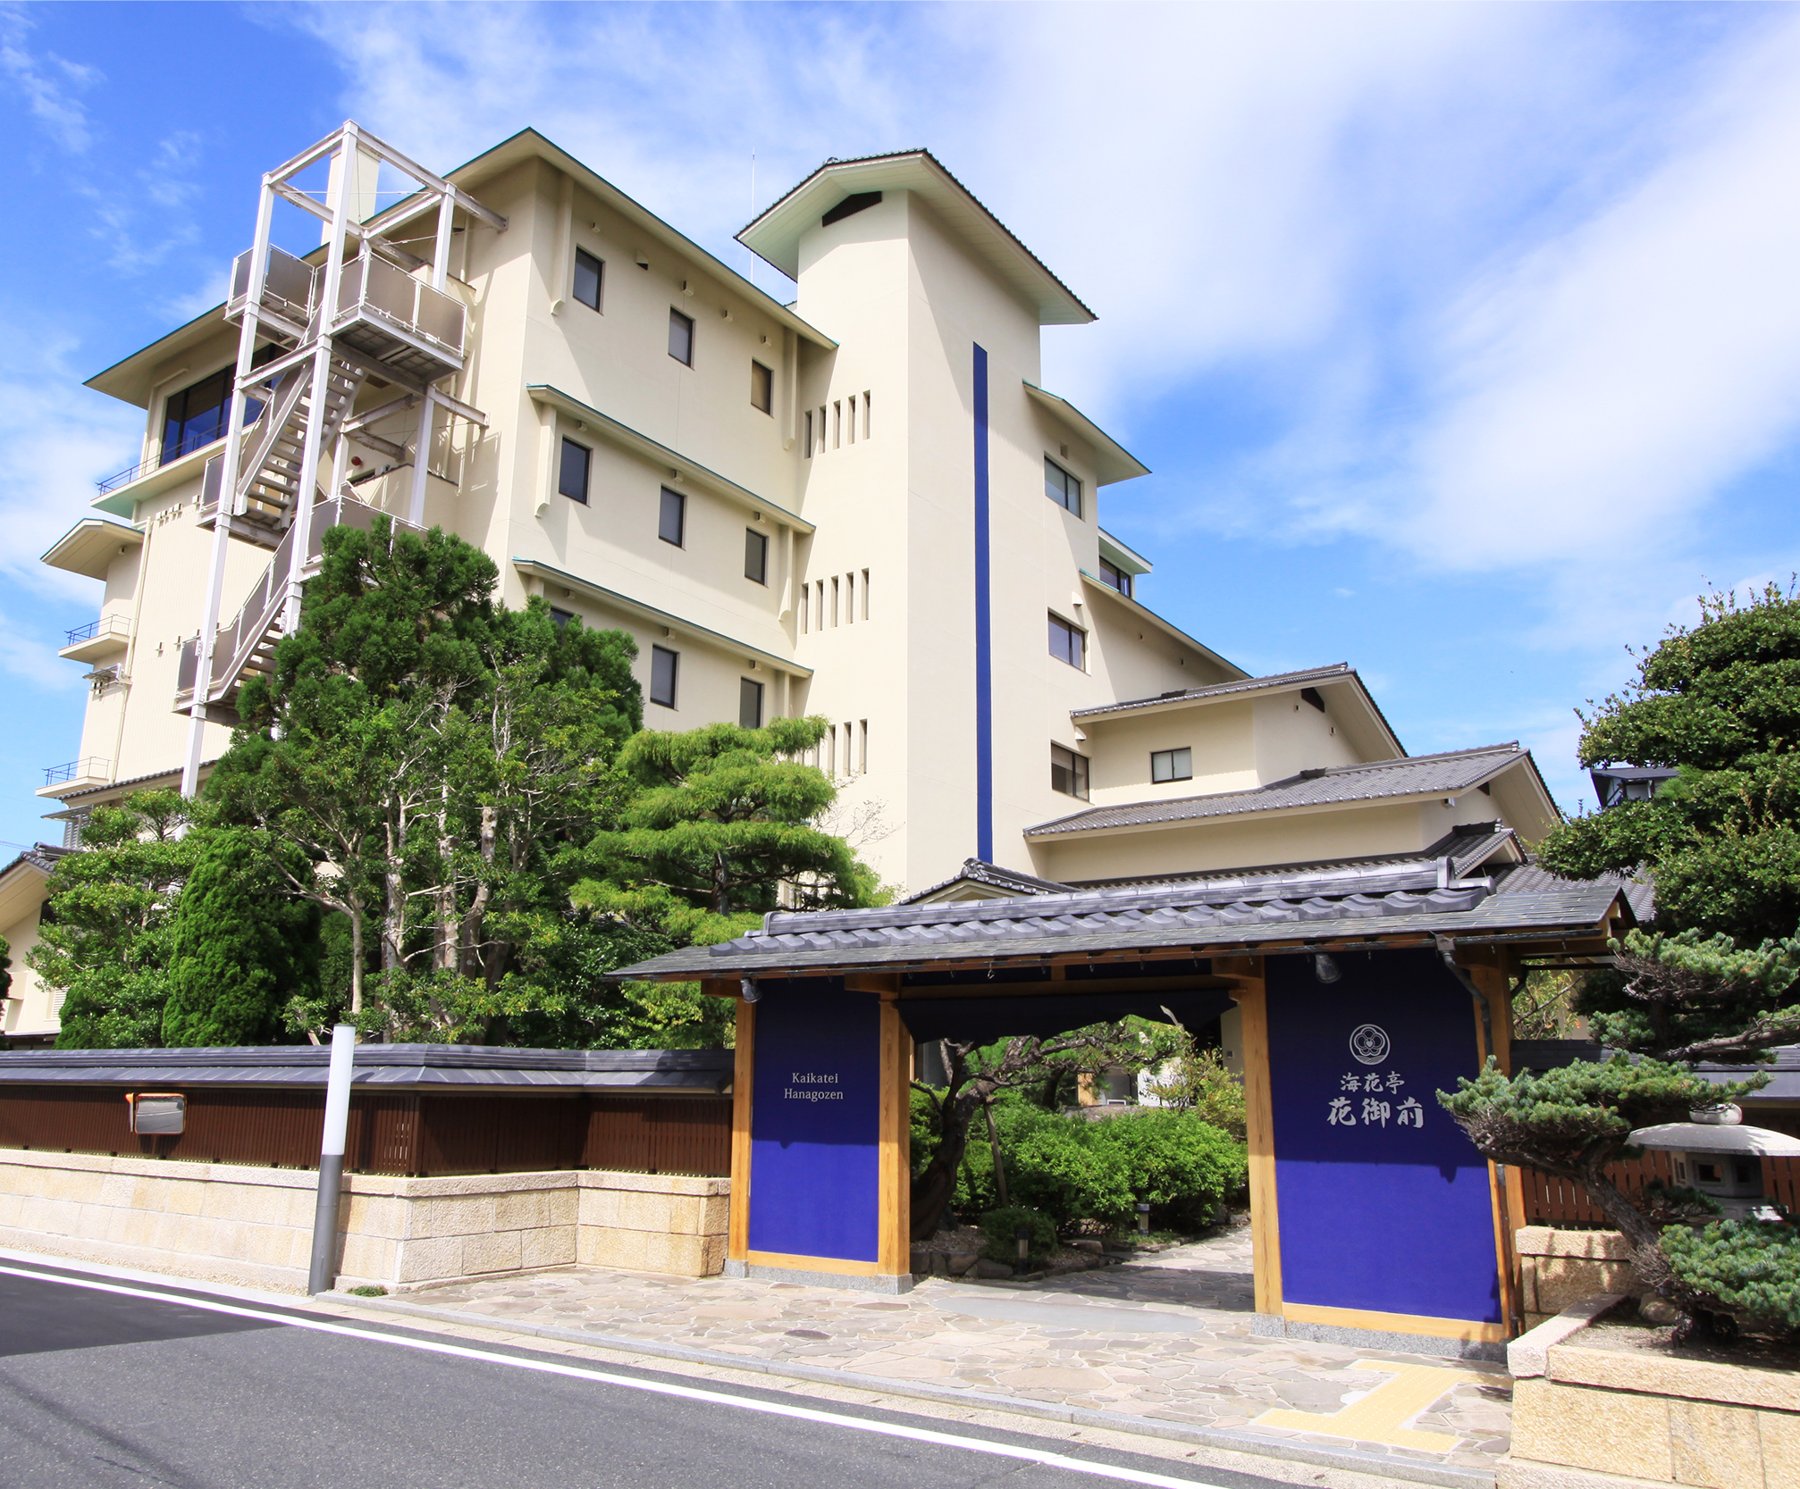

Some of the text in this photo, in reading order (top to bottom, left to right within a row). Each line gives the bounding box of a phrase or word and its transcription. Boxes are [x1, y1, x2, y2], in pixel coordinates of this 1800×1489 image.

[792, 1072, 839, 1084] Kaikatei
[1340, 1070, 1405, 1095] 海花亭
[784, 1088, 844, 1102] Hanagozen
[1327, 1096, 1424, 1128] 花御前
